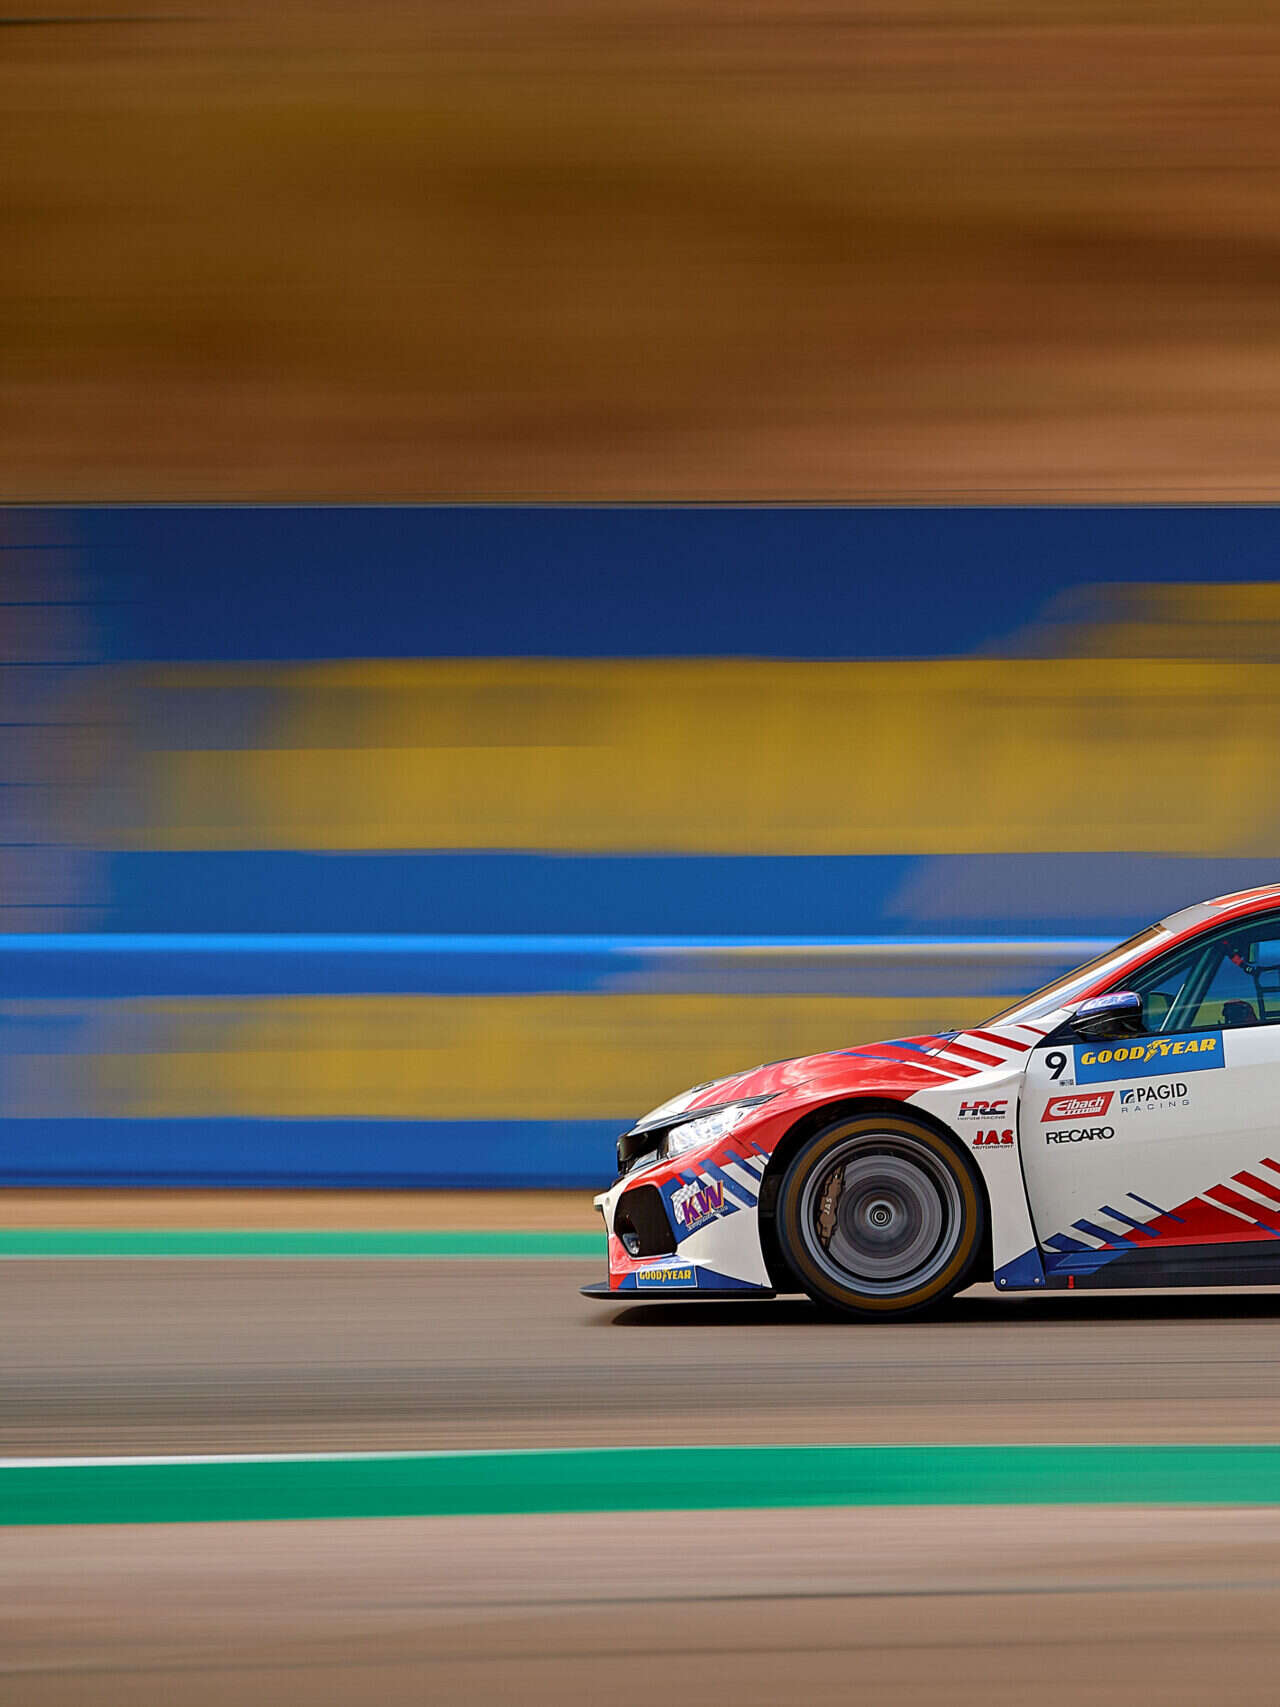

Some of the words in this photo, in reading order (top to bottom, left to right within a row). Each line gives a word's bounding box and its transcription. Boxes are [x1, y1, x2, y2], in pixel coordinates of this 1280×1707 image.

[1081, 1038, 1215, 1066] GOODYEAR
[1045, 1051, 1067, 1080] 9
[1136, 1083, 1187, 1102] PAGID
[959, 1100, 1008, 1116] HRC
[1049, 1096, 1105, 1117] Eibach
[1121, 1100, 1190, 1113] RACING
[973, 1129, 1014, 1145] JAS
[1046, 1126, 1115, 1144] RECARO
[681, 1180, 724, 1226] KW
[640, 1269, 692, 1283] GOODYEAR
